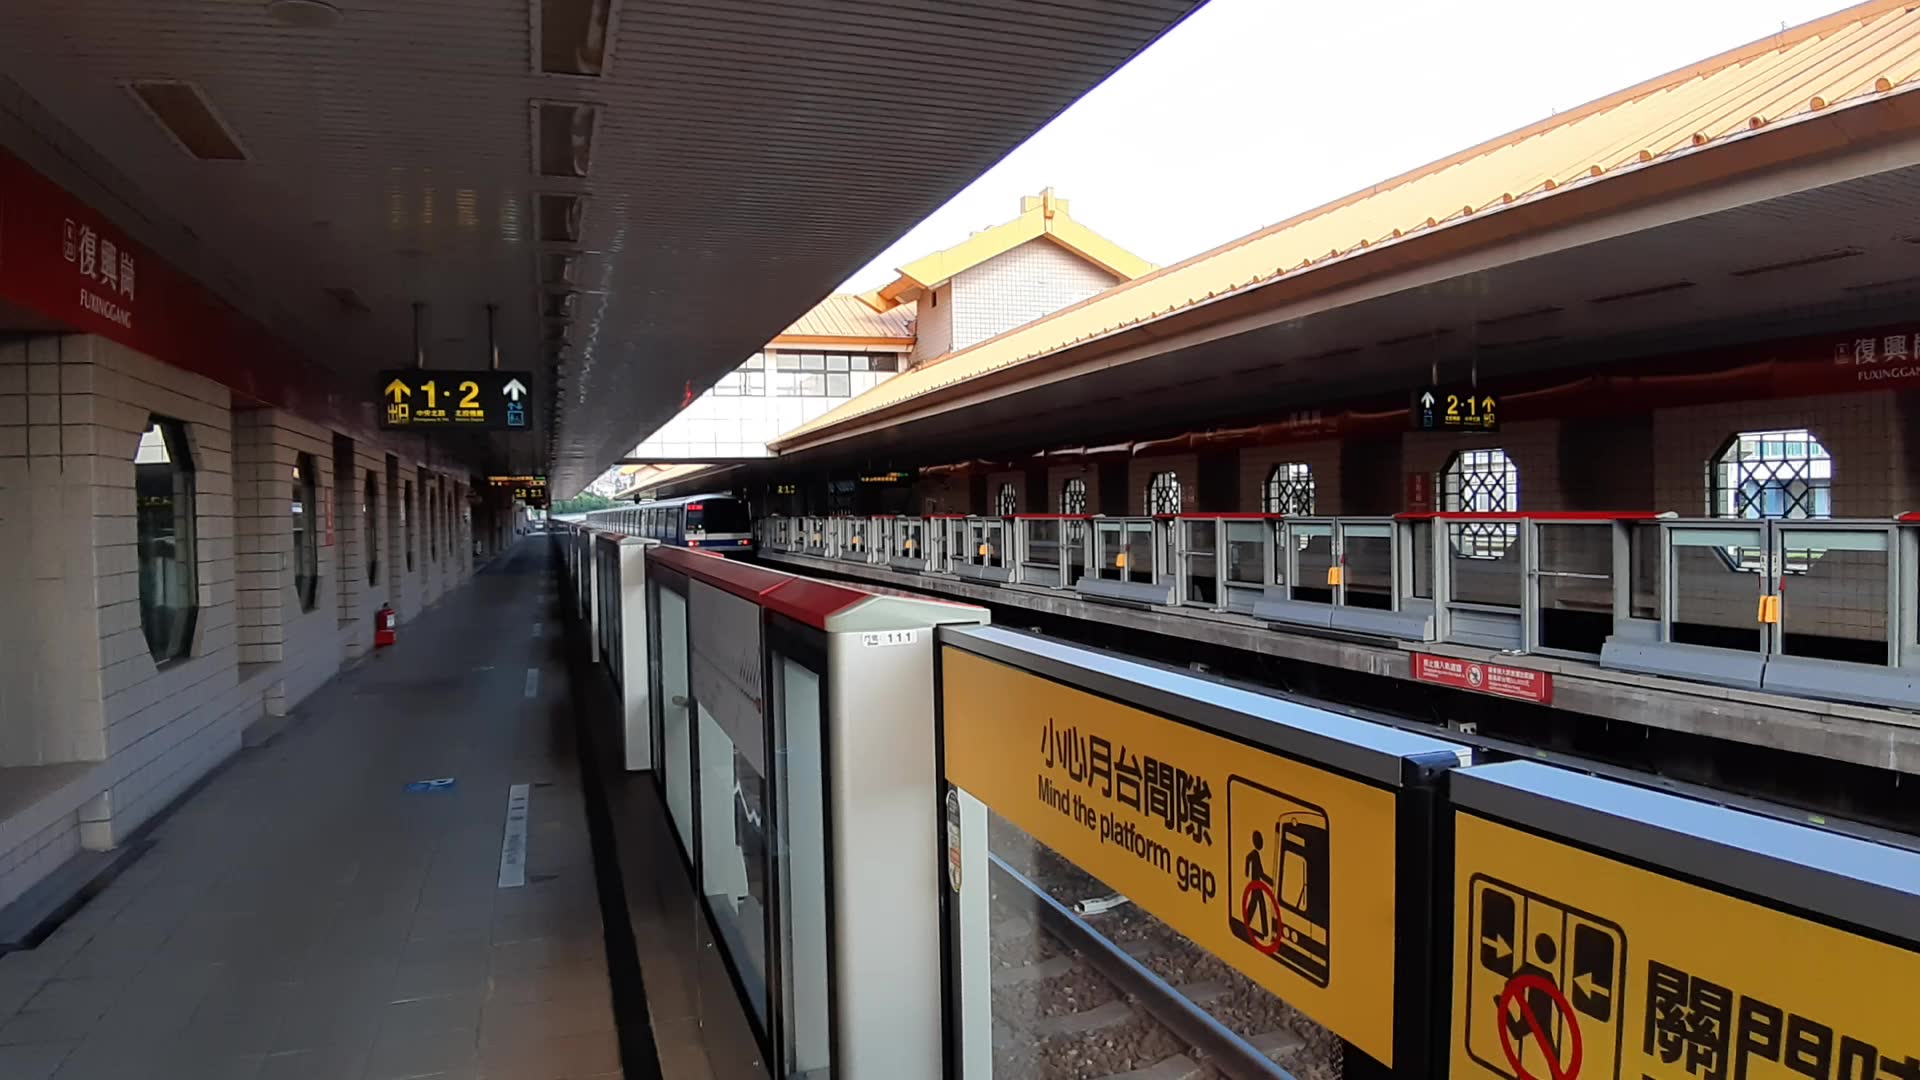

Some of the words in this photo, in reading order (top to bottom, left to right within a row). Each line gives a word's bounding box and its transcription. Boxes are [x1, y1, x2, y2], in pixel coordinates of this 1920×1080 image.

[80, 224, 135, 301] 復興崗
[888, 632, 911, 643] 111
[1041, 717, 1213, 847] 小心月台間隙
[1039, 775, 1070, 816] Mind
[1073, 795, 1096, 831] the
[1100, 813, 1172, 874] platform
[1176, 855, 1216, 904] gap
